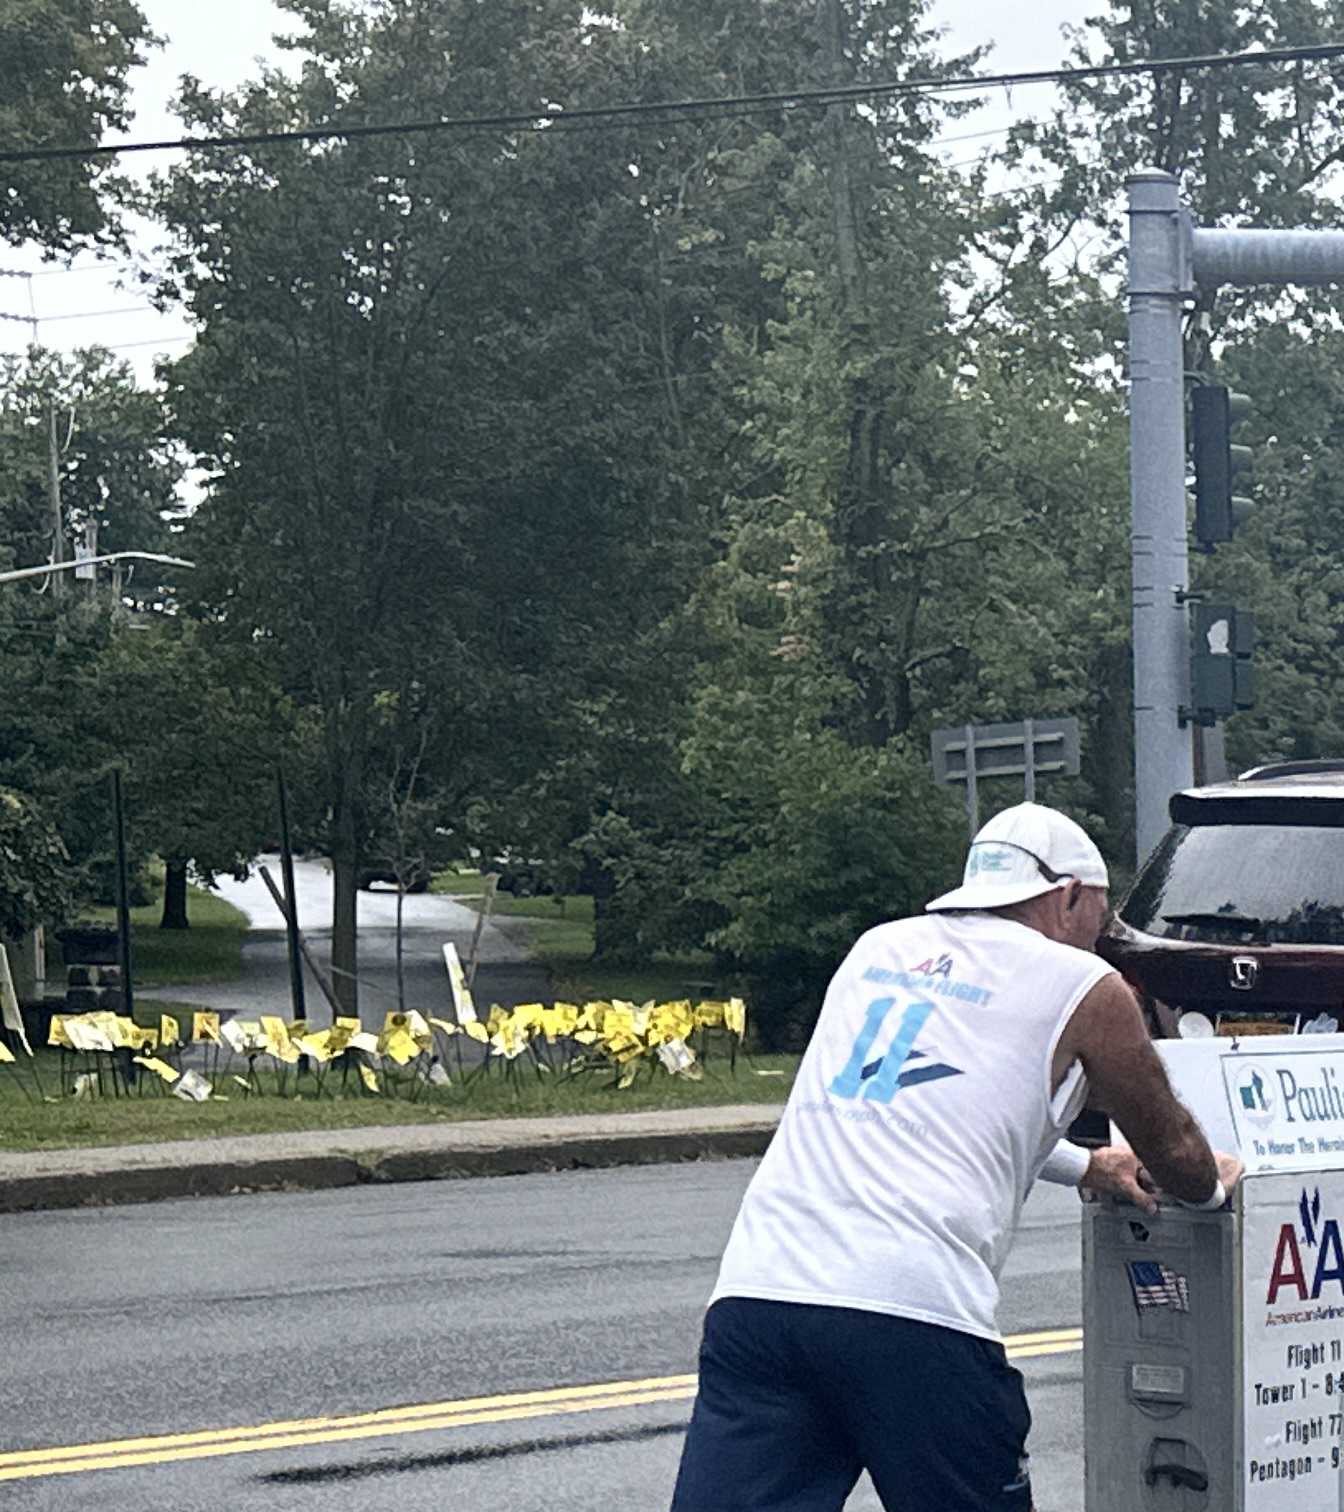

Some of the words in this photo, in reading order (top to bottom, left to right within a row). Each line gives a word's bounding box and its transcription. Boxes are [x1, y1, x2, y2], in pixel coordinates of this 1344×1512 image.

[1287, 1342, 1325, 1369] Flight
[1330, 1340, 1342, 1362] 11
[1255, 1381, 1295, 1406] Tower
[1300, 1378, 1307, 1399] 1
[1286, 1417, 1324, 1444] Flight
[1329, 1413, 1343, 1436] 77
[1250, 1455, 1312, 1483] Pentagon
